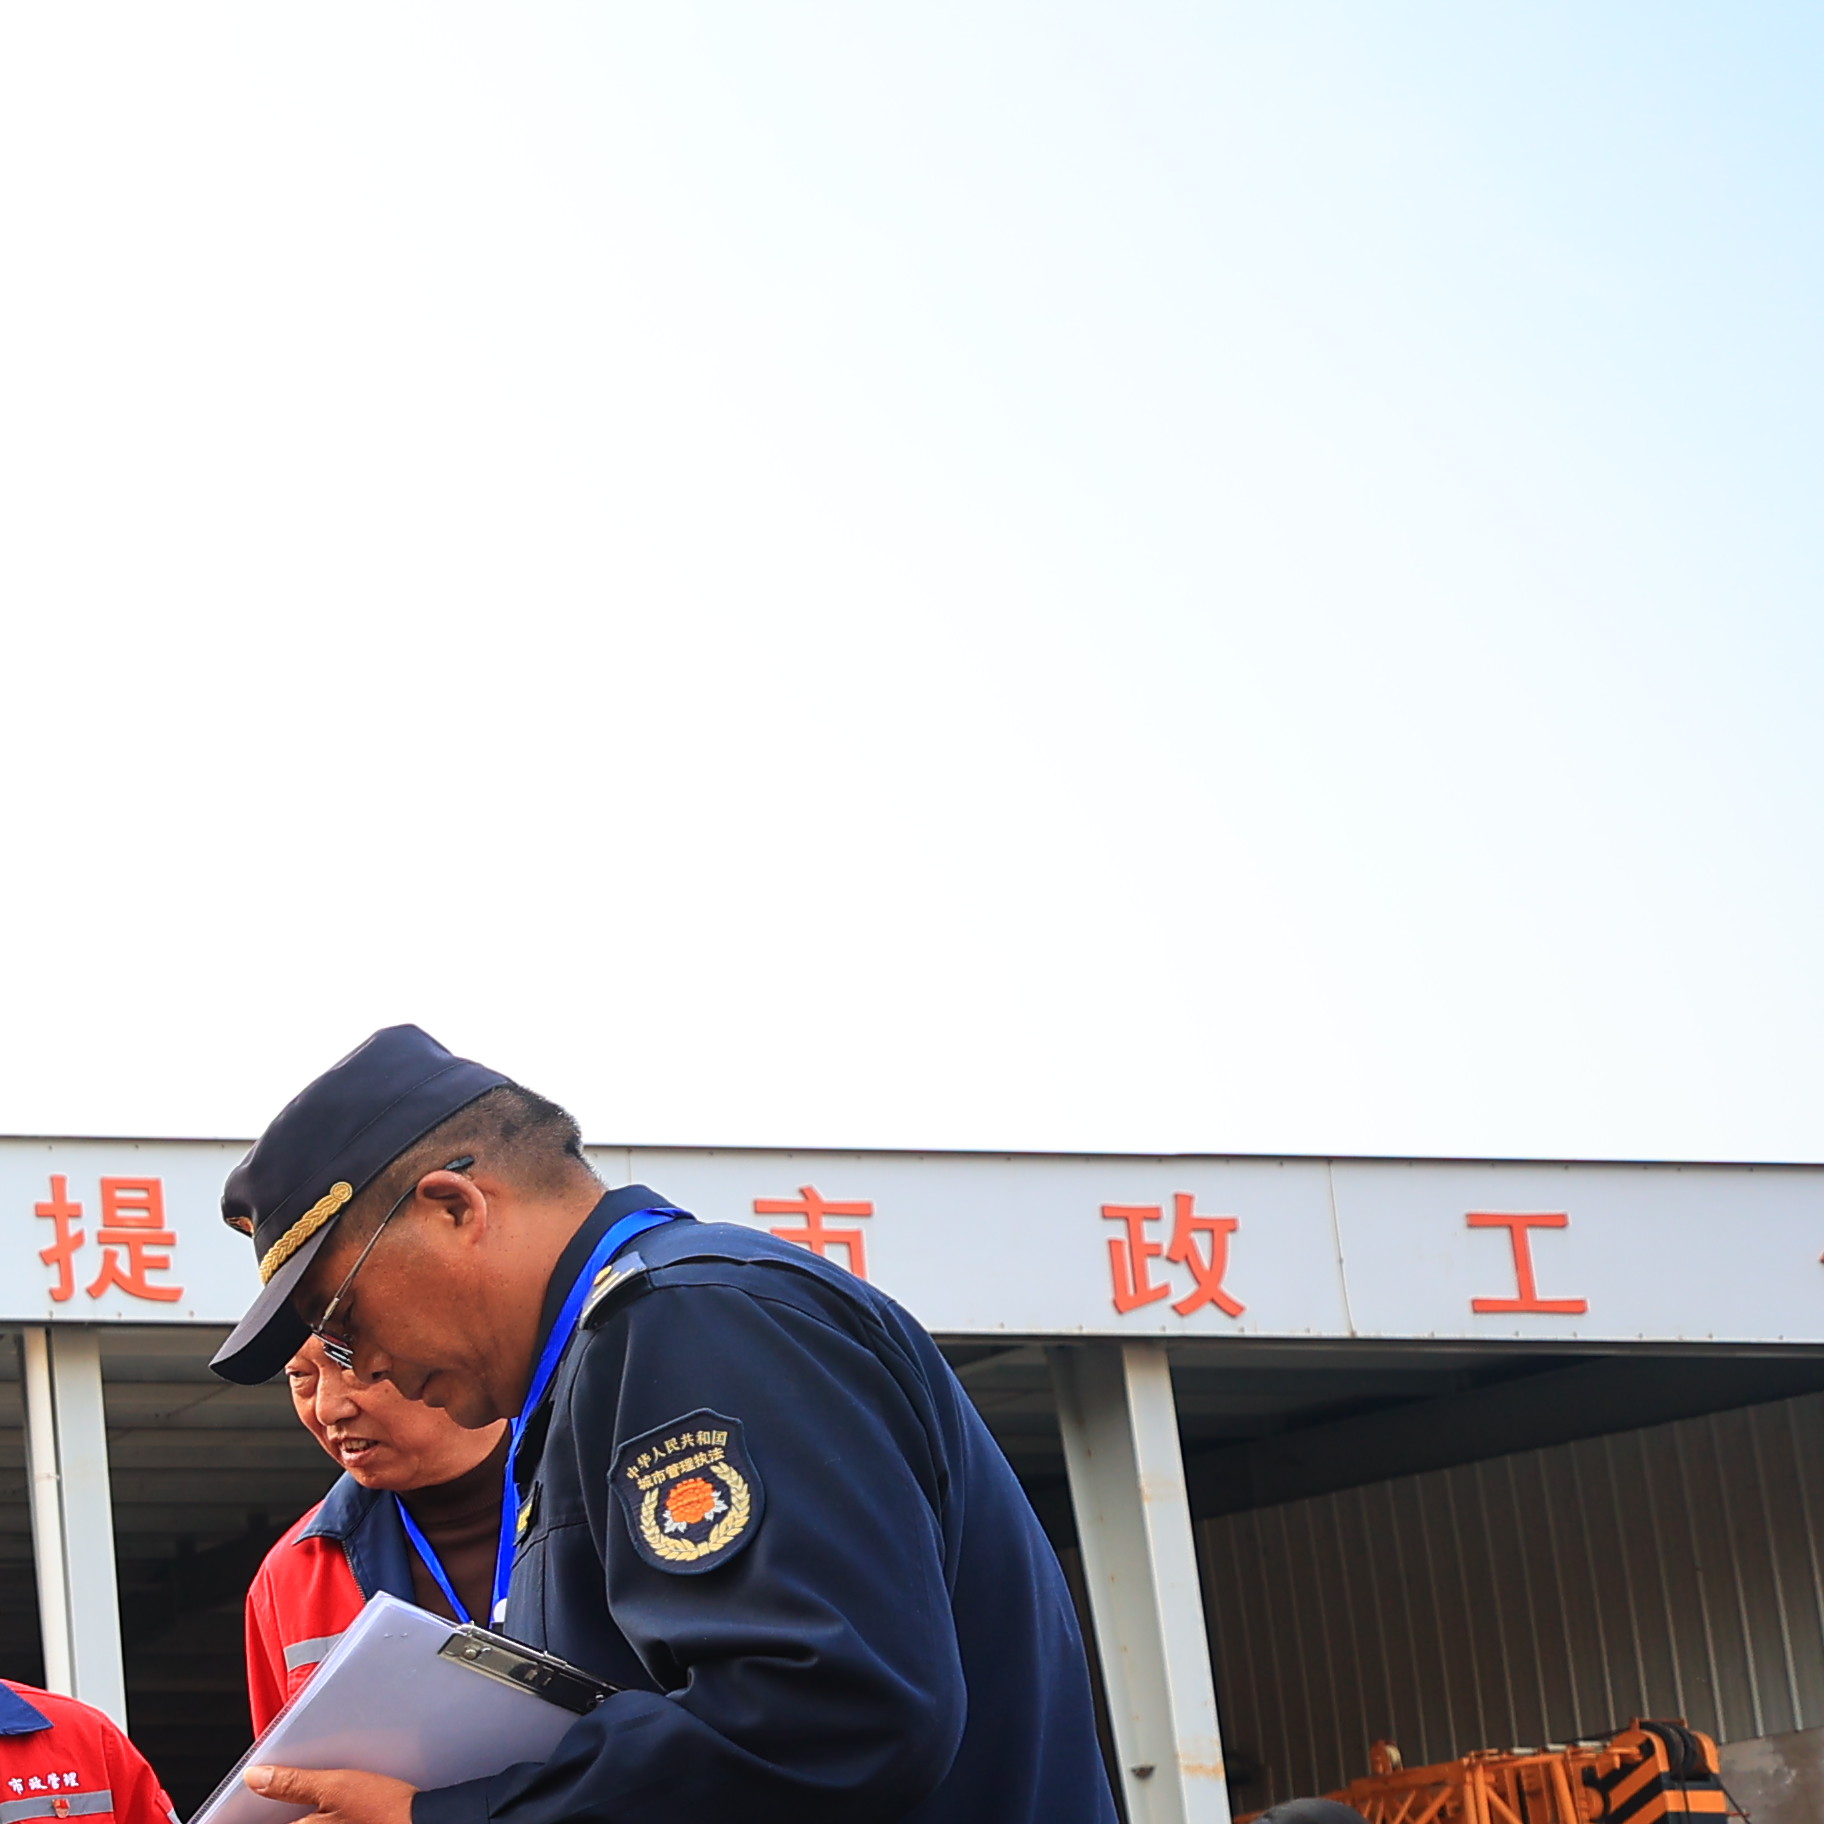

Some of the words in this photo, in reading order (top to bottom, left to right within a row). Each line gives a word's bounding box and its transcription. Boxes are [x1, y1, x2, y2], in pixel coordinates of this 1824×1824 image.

[626, 1430, 728, 1480] 中华人民共和国
[637, 1447, 726, 1491] 城市管理执法
[7, 1772, 80, 1796] 市政管理
